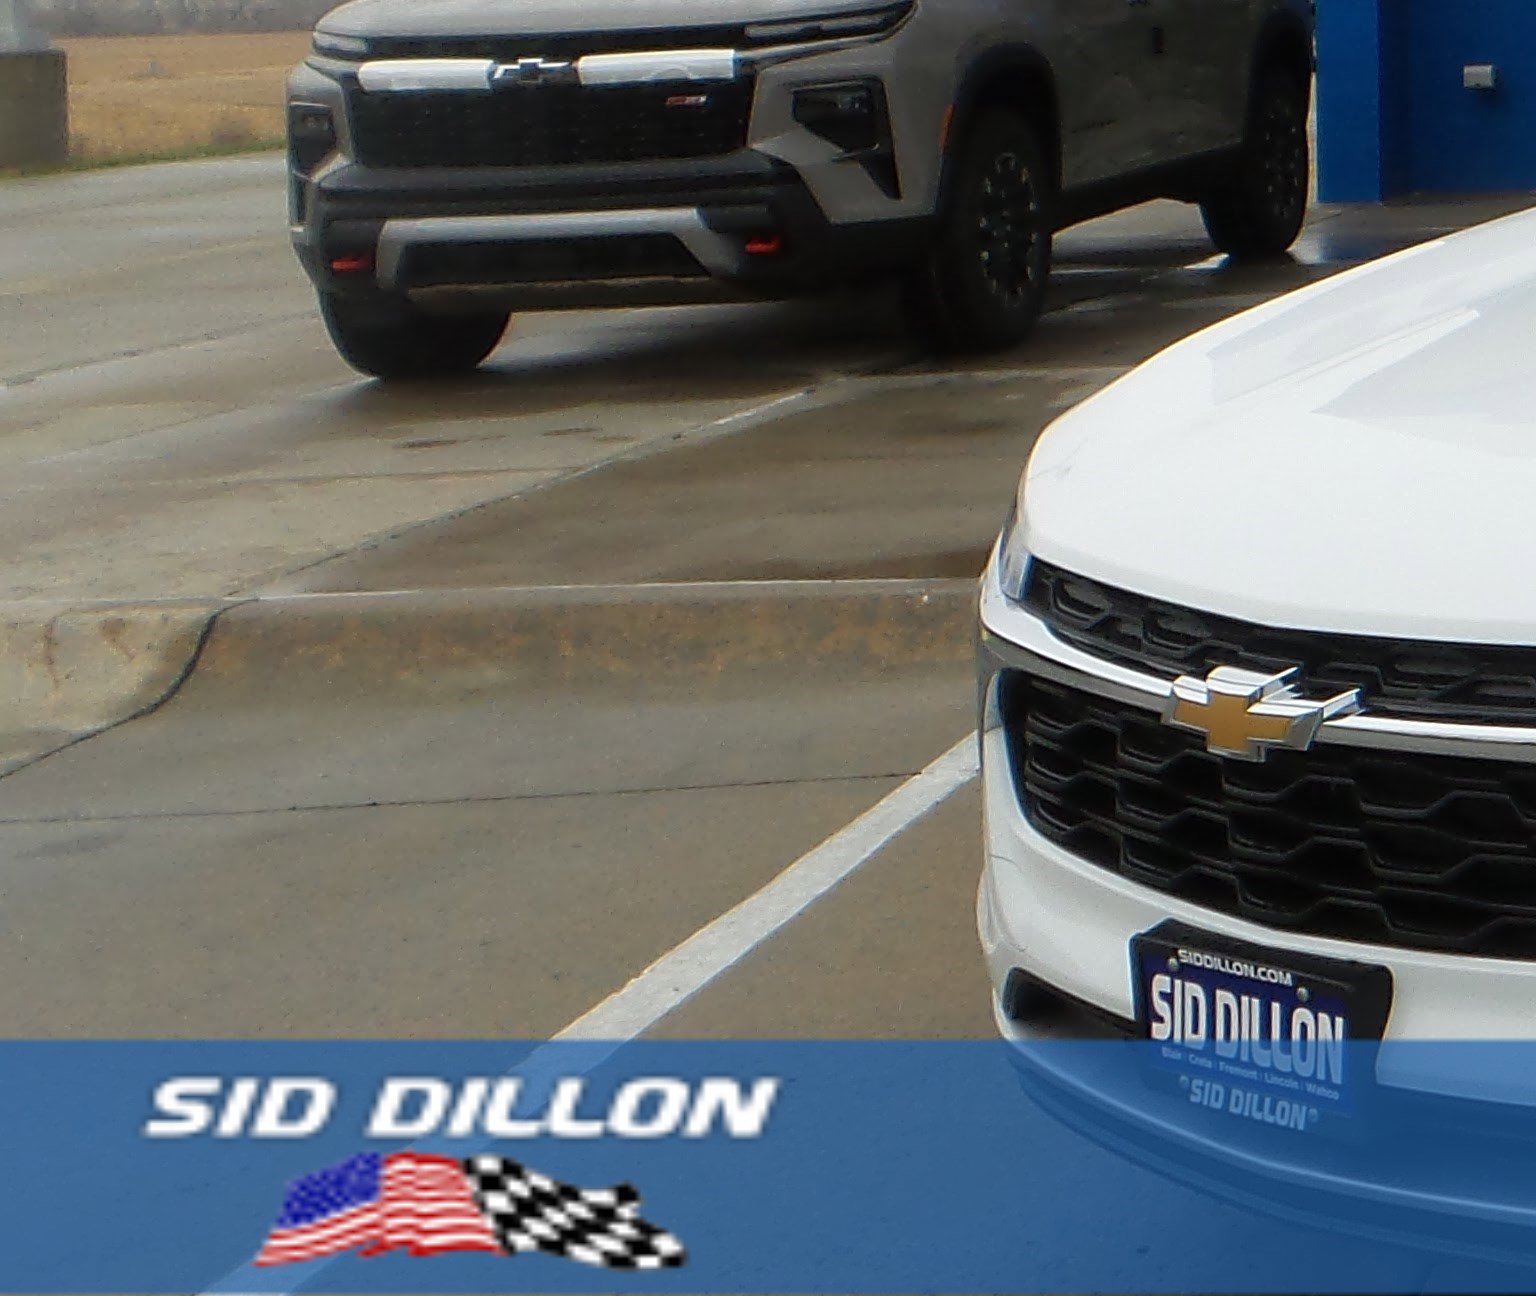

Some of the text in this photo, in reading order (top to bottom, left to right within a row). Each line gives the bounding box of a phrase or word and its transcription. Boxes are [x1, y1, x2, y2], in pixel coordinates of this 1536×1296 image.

[1178, 949, 1292, 986] SIDDILLON.COM
[1151, 973, 1344, 1085] SID DILLON
[1190, 1079, 1307, 1130] SID DILLON
